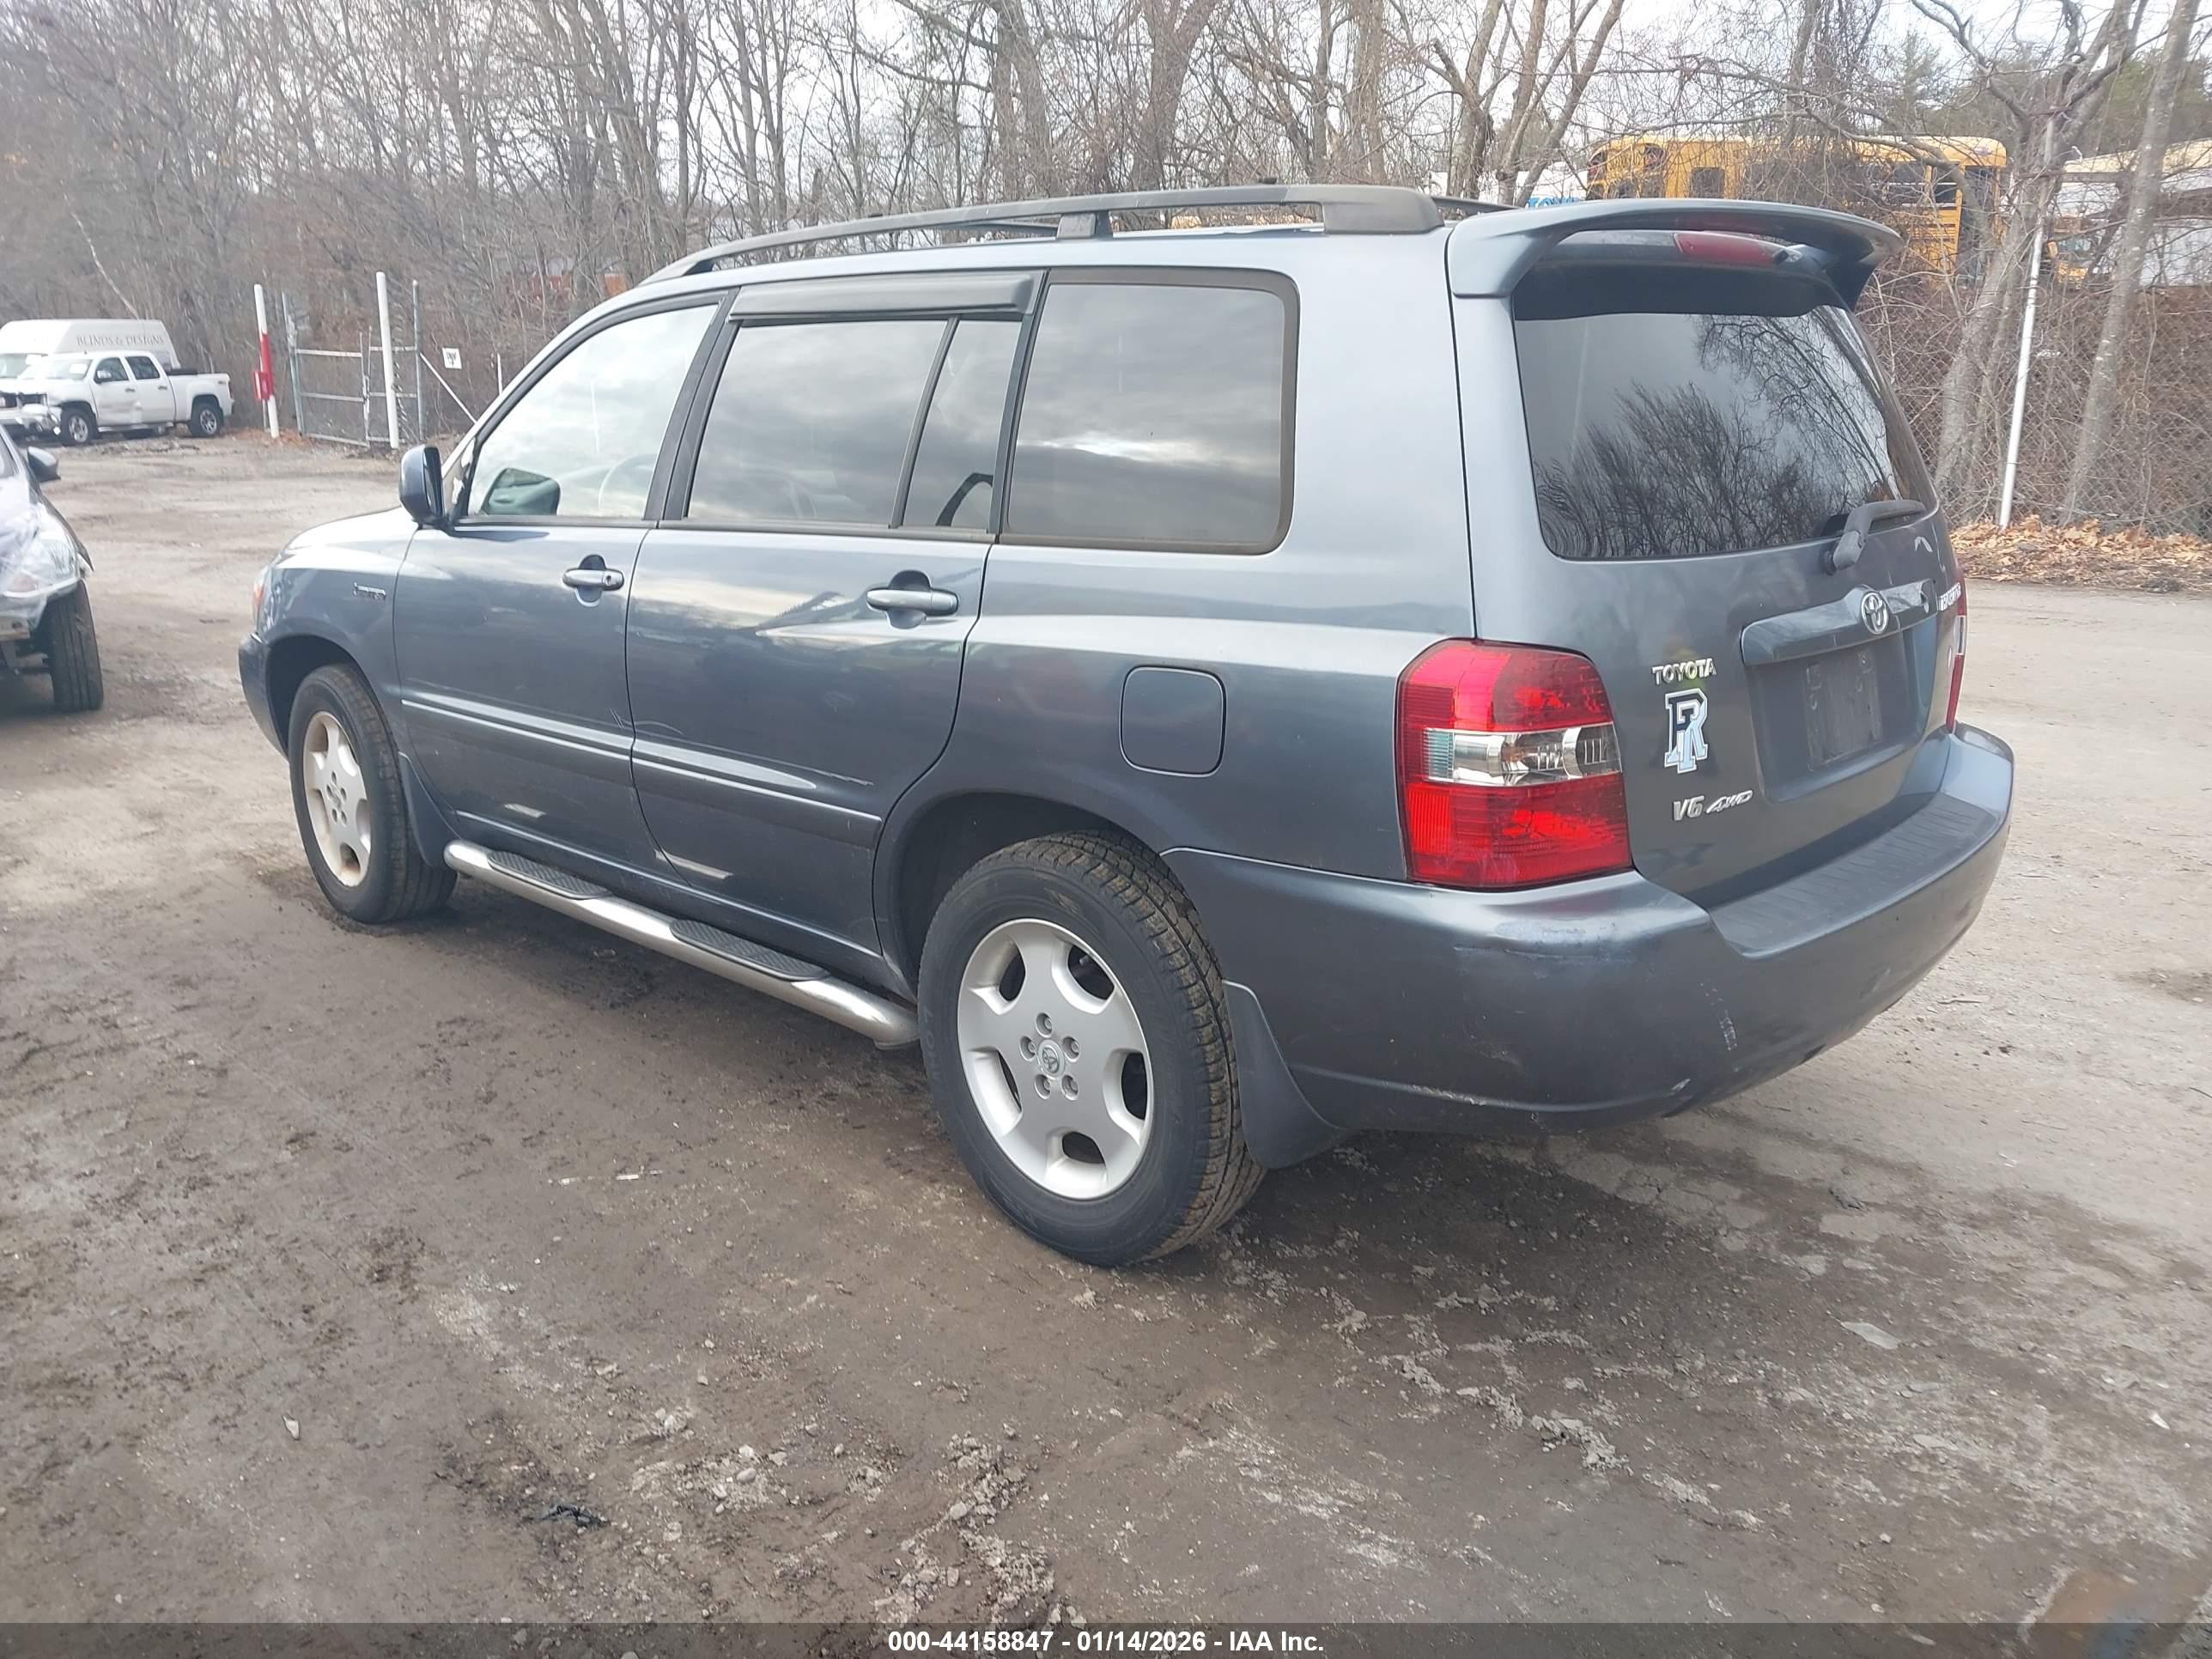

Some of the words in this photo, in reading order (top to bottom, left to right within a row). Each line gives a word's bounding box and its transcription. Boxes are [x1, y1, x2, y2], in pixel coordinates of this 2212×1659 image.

[76, 336, 113, 346] BLINDS
[115, 336, 124, 345] &
[125, 335, 166, 345] DESIGNS
[1652, 658, 1717, 685] TOYOTA
[1672, 795, 1705, 822] V6
[1705, 790, 1753, 814] 4WD
